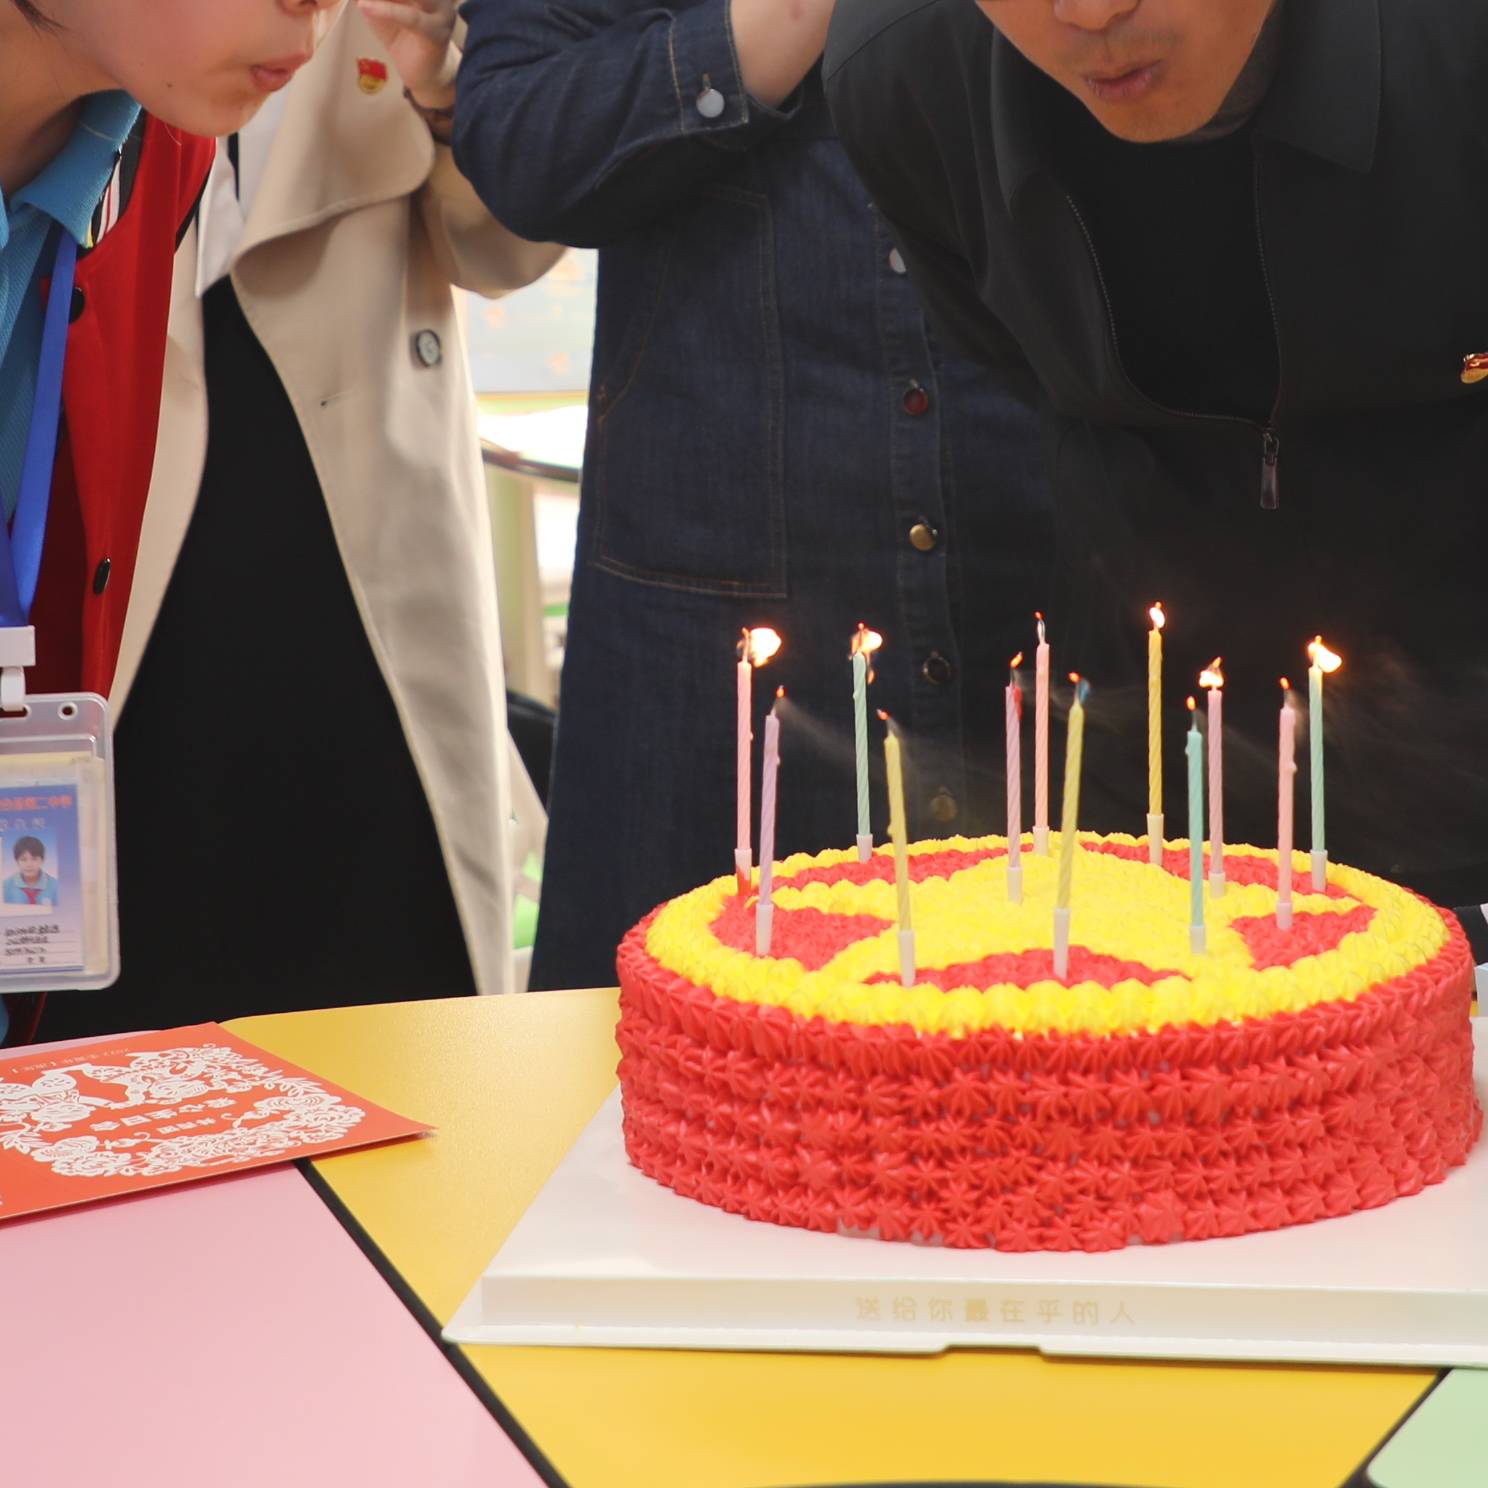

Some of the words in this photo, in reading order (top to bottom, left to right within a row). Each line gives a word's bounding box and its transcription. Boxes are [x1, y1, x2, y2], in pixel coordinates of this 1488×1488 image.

[855, 1296, 1137, 1327] 送给你最在乎的人
